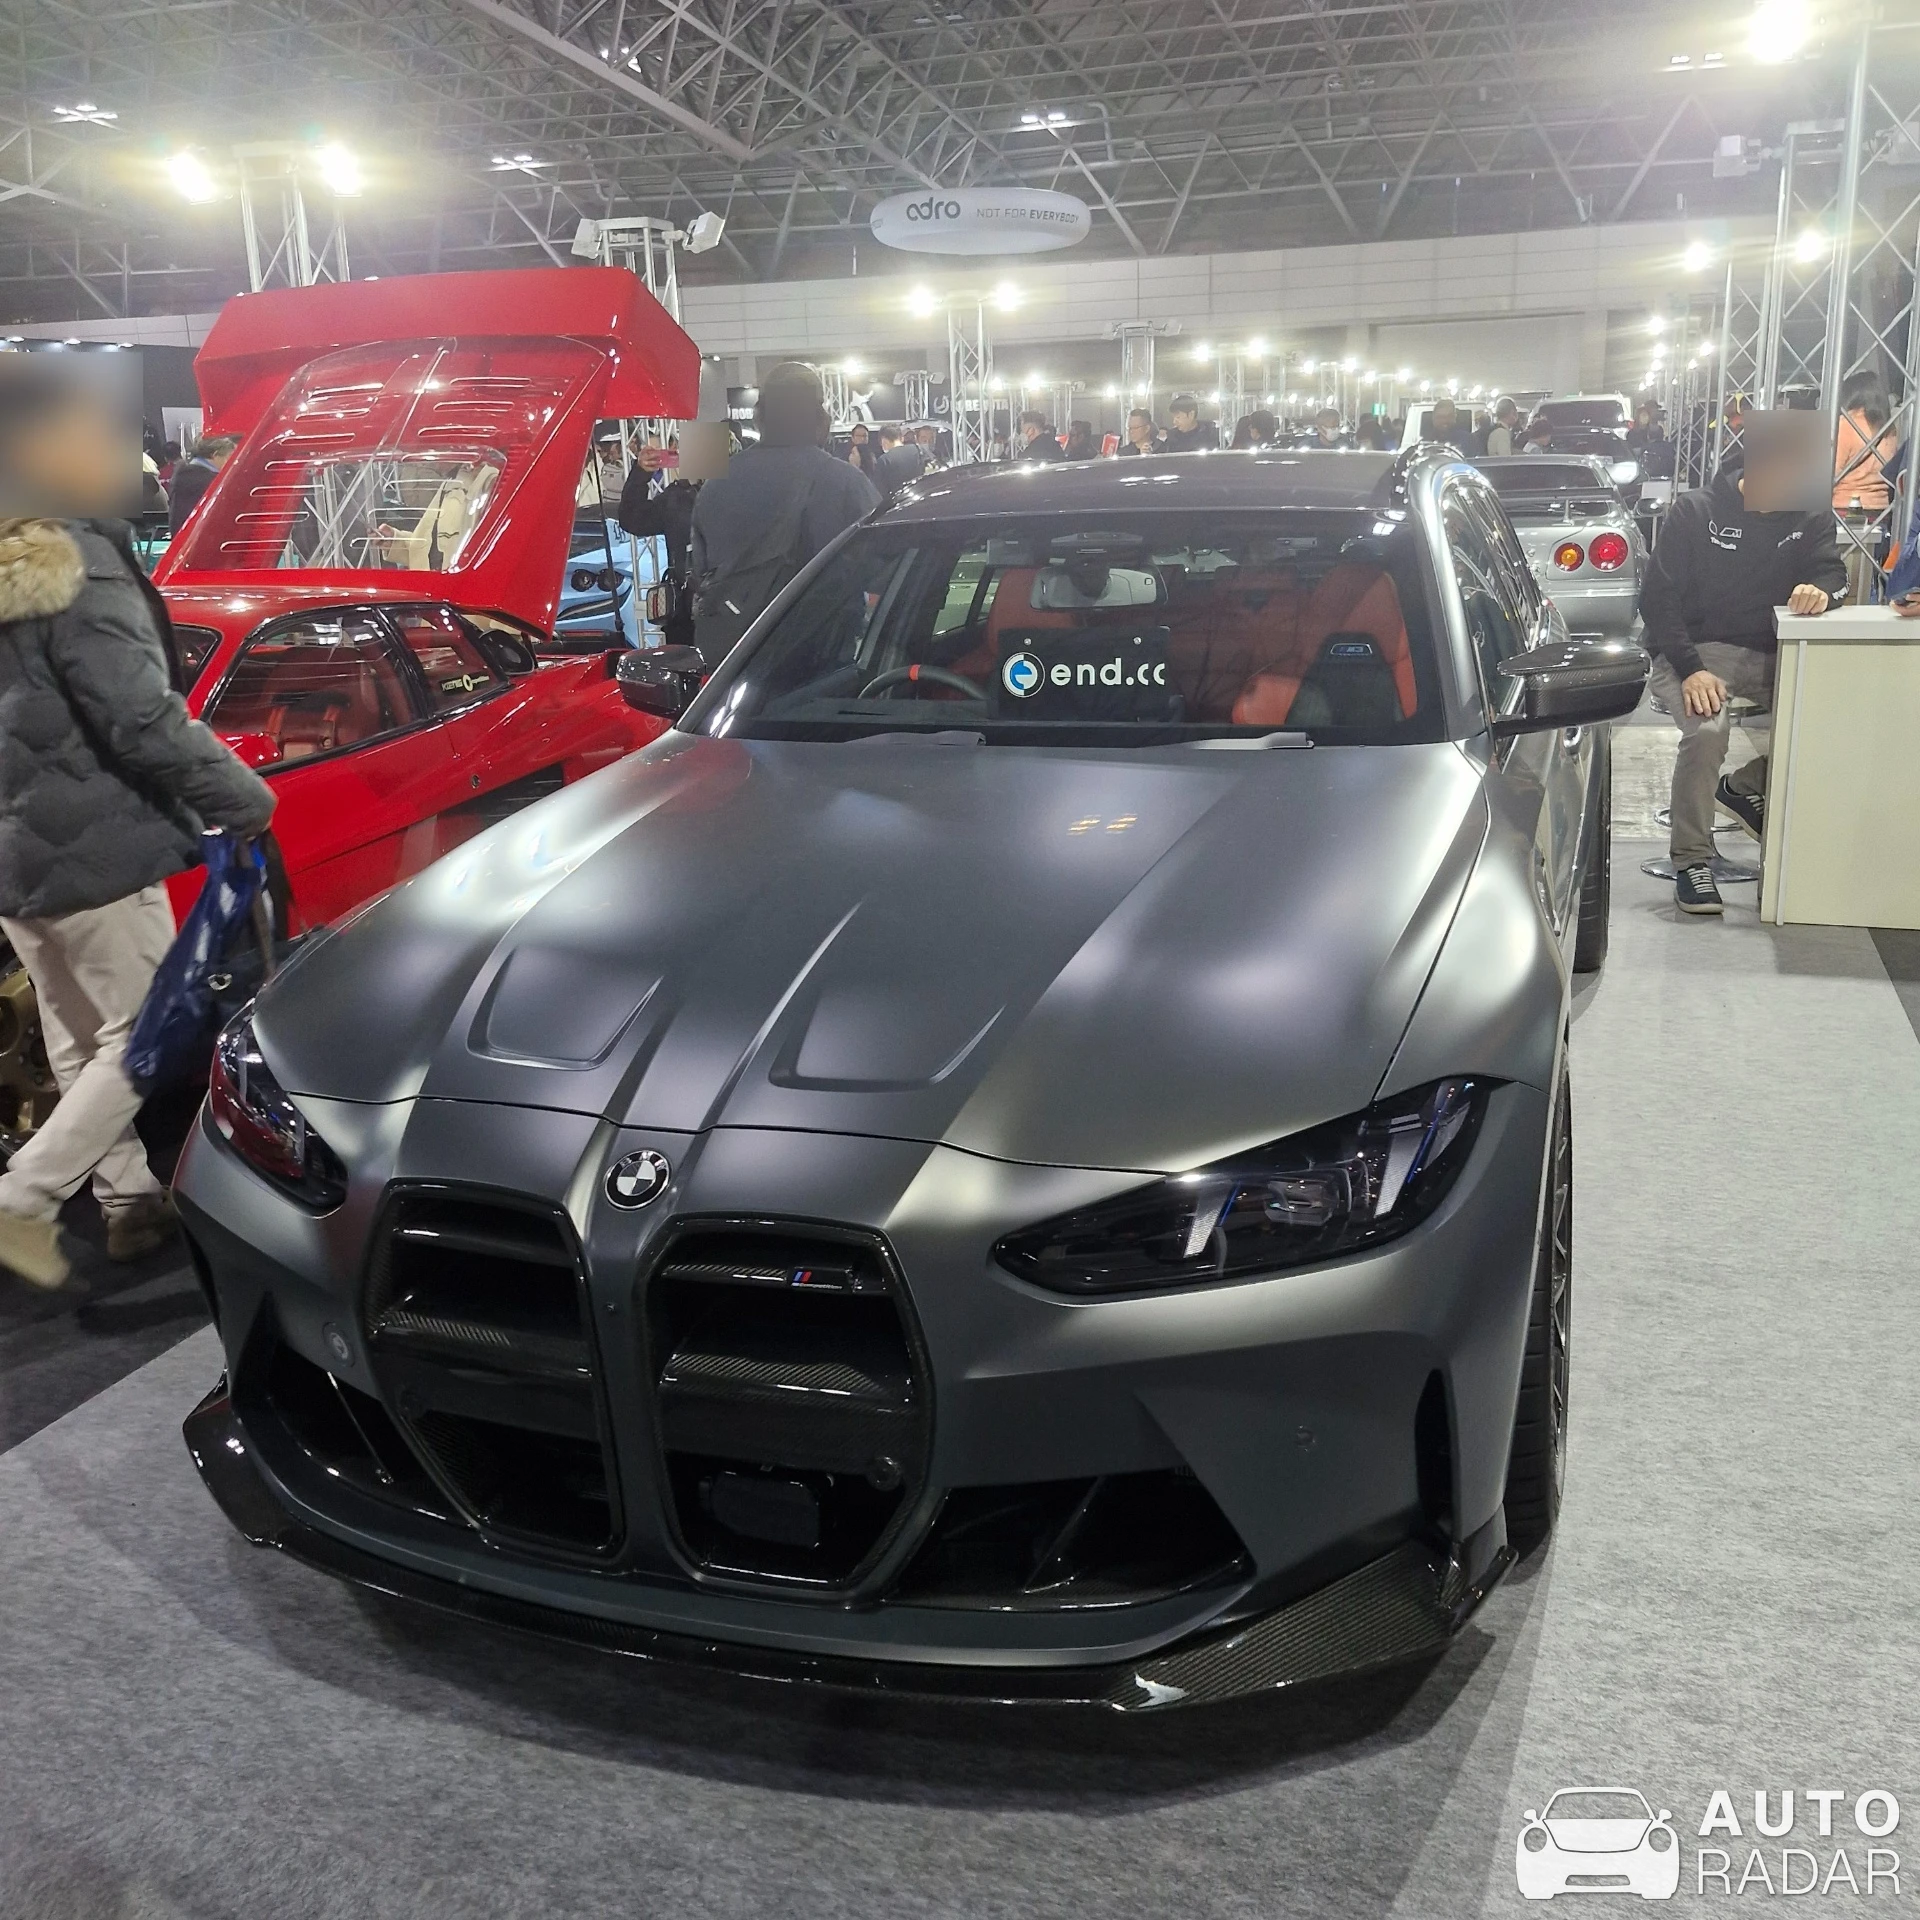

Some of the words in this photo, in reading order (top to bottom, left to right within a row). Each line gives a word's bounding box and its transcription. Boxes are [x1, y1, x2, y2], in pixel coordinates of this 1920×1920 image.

[906, 197, 961, 222] adro
[976, 208, 1001, 218] NOT
[1004, 208, 1027, 218] FOR
[1029, 209, 1080, 223] EVERYBODY
[1050, 657, 1165, 686] end.cc
